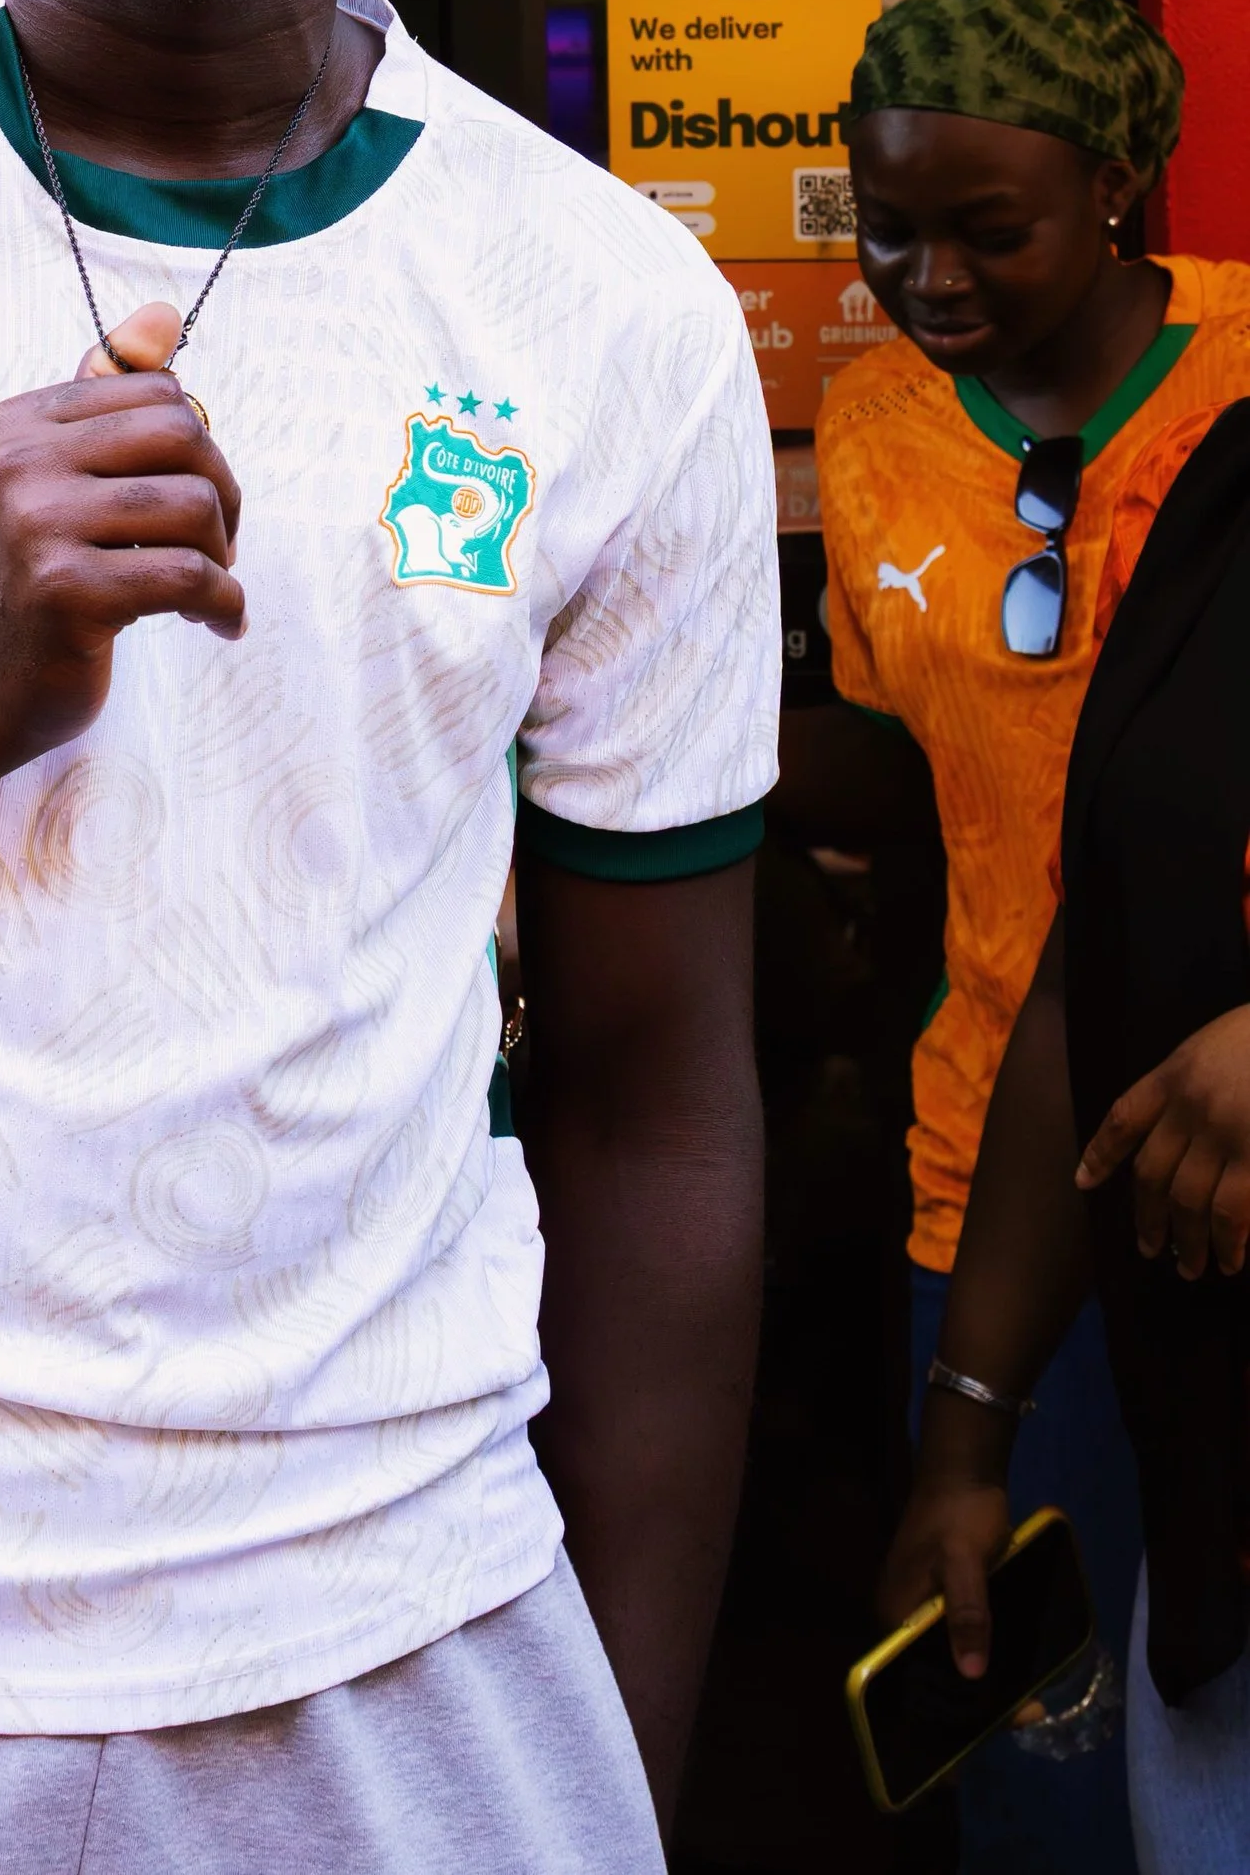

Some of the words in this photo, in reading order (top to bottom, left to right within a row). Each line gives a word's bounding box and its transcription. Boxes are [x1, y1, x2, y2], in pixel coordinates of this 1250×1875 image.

[630, 17, 676, 40] We
[684, 16, 783, 40] deliver
[631, 47, 692, 71] with
[463, 457, 518, 495] D'IVOIRE
